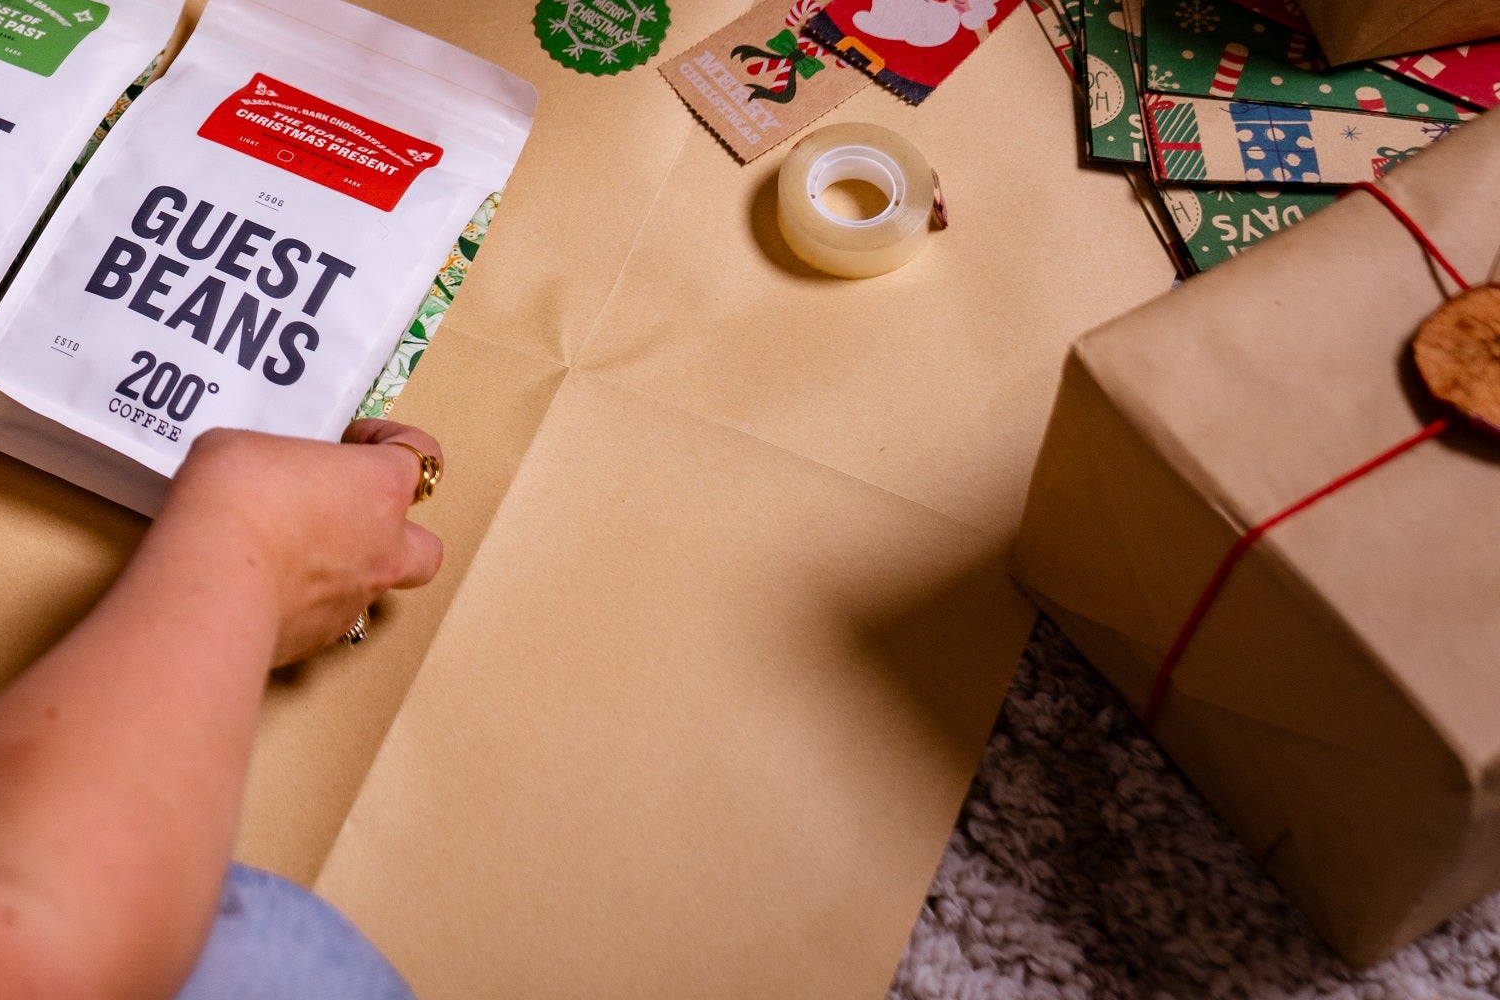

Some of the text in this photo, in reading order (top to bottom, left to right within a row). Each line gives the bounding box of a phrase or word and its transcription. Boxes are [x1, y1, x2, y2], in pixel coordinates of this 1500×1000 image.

[3, 19, 47, 40] PAST
[20, 14, 43, 25] OF
[570, 2, 632, 43] CHRISTMAS
[680, 62, 762, 145] CHRISTMAS
[694, 50, 782, 133] MERRY
[235, 108, 326, 148] CHRISTMAS
[326, 142, 400, 176] PRESENT
[239, 135, 260, 148] LIGHT
[273, 111, 379, 155] THE ROAST OF
[301, 109, 329, 121] DARK
[329, 117, 381, 145] CHOCOLATE
[257, 191, 285, 207] 250G
[343, 177, 362, 189] DARK
[130, 185, 357, 318] GUEST
[84, 235, 320, 386] BEANS
[53, 335, 81, 352] ESTD
[115, 350, 220, 422] 200°
[108, 397, 183, 443] COFFEE
